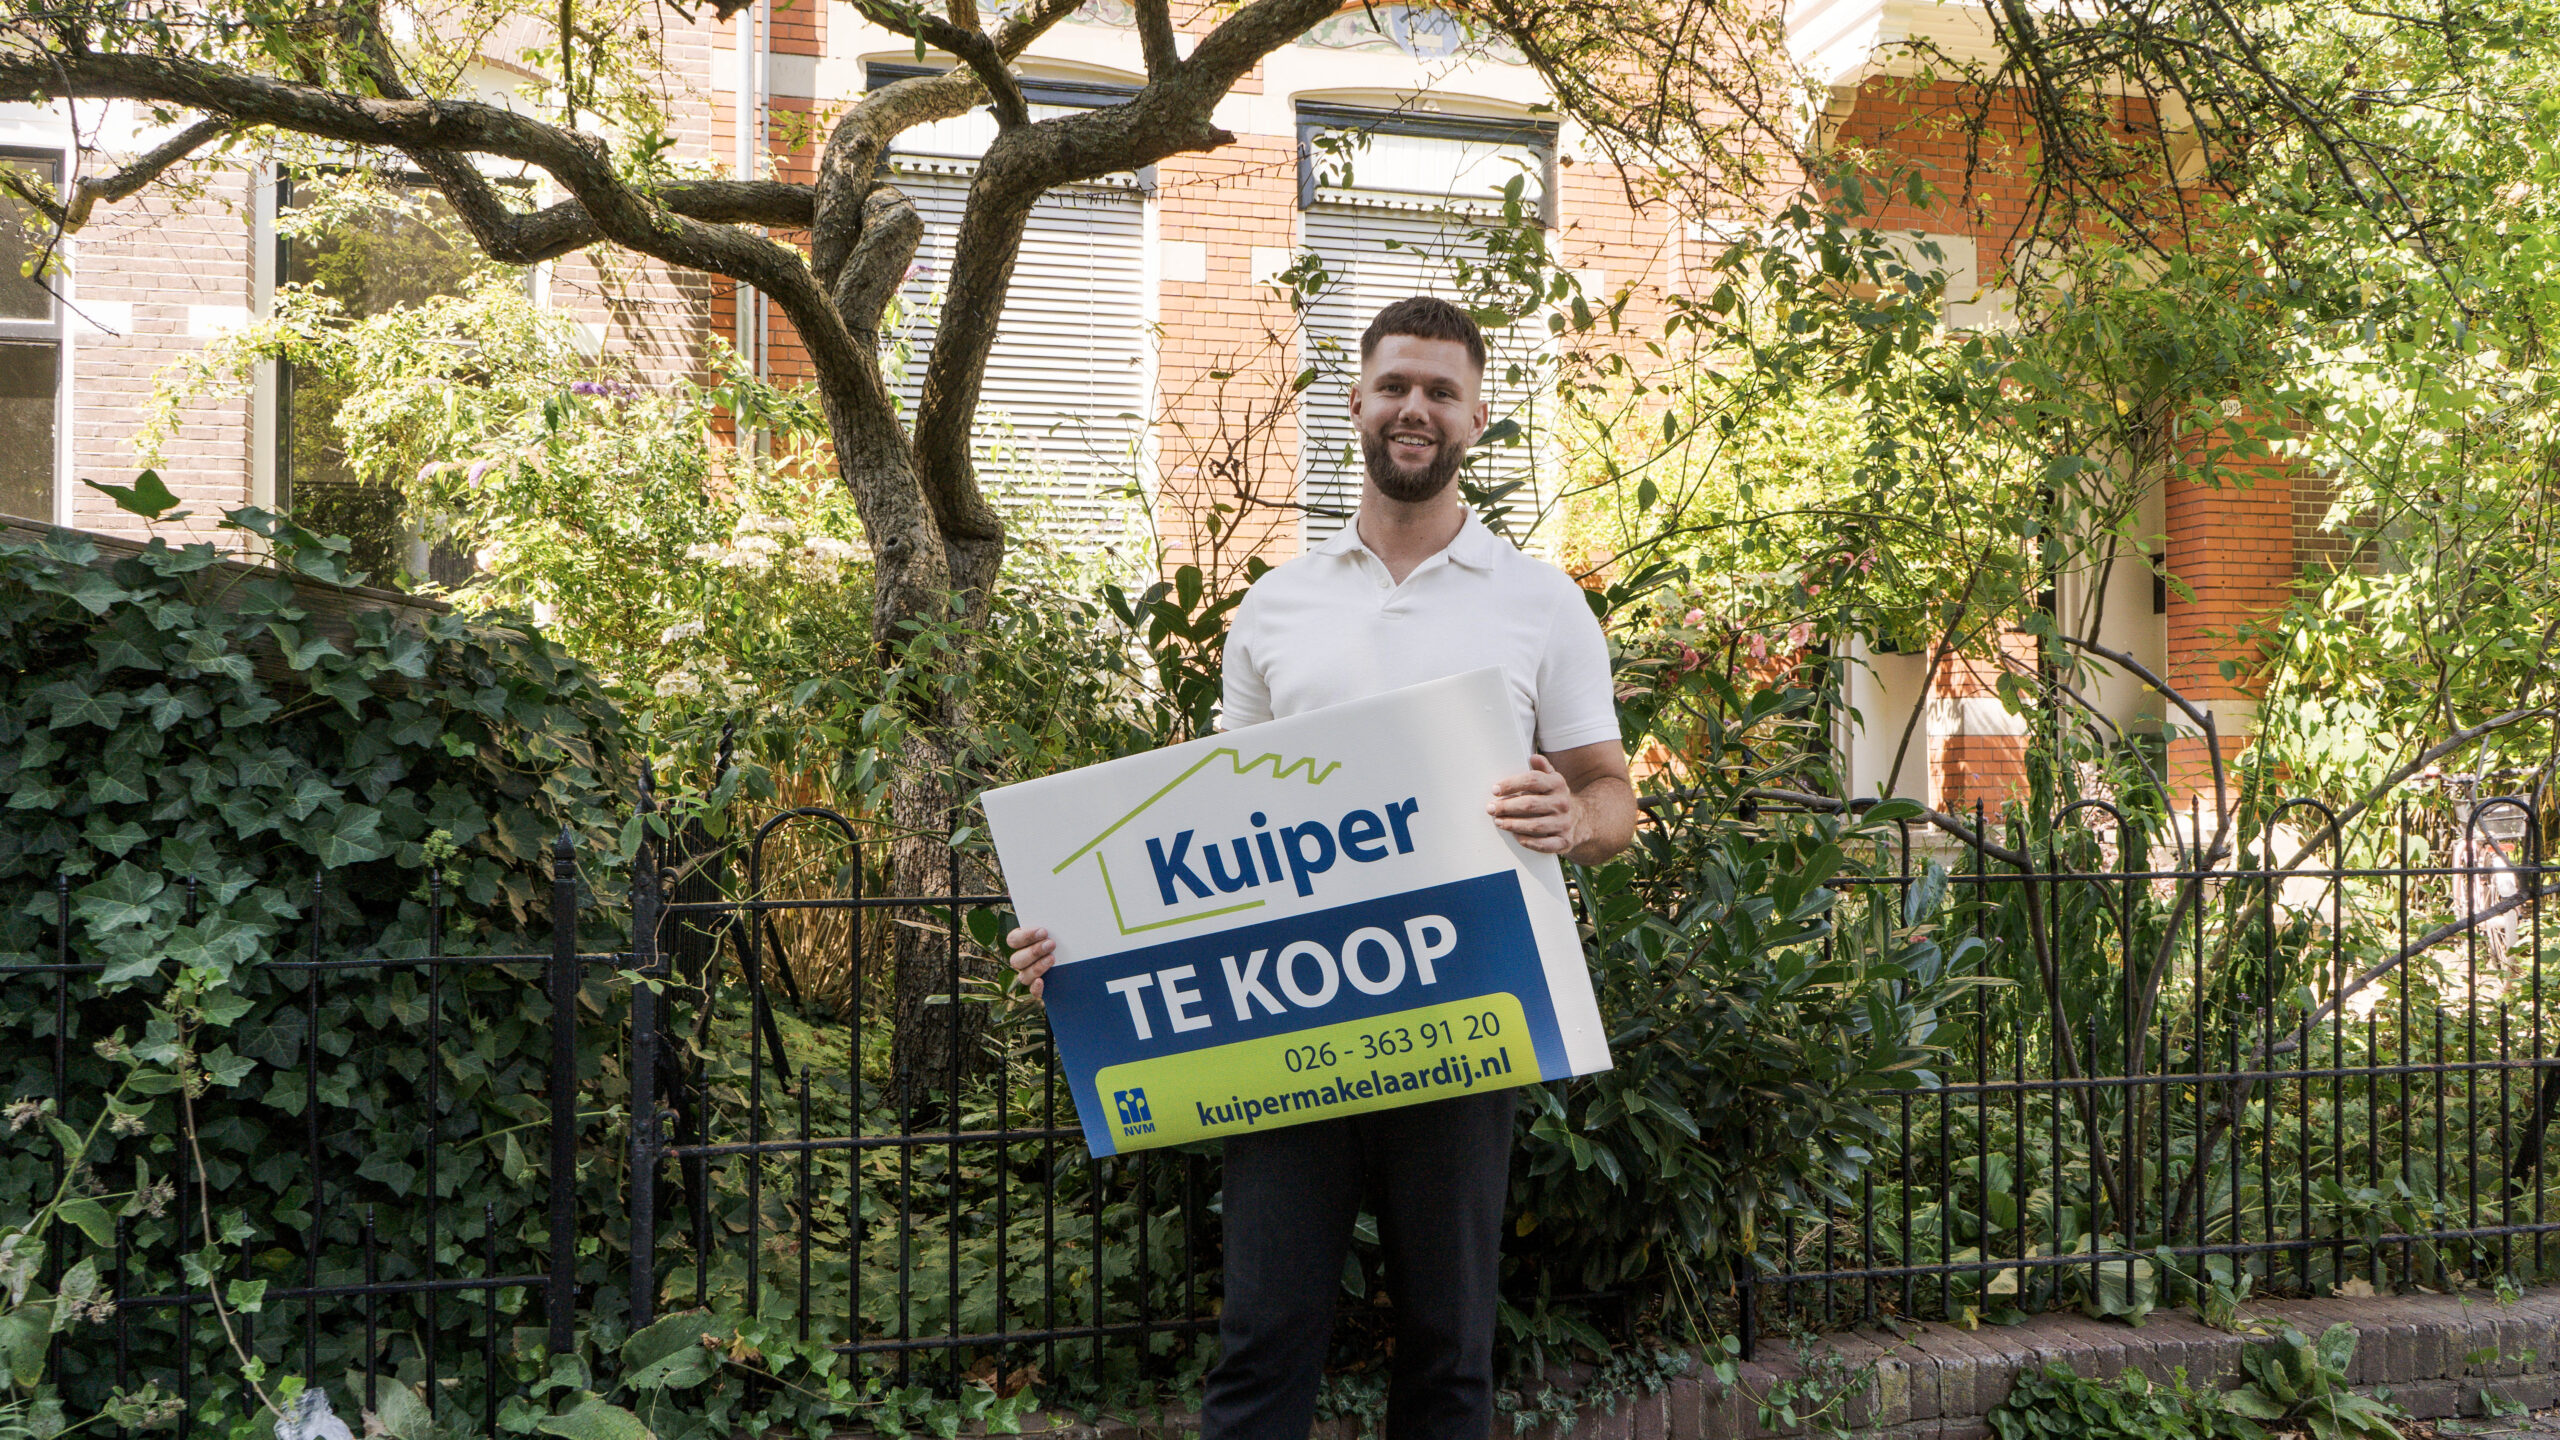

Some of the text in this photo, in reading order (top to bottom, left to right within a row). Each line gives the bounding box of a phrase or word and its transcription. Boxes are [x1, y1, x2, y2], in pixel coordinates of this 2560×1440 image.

[1146, 797, 1418, 905] Kuiper
[1106, 915, 1457, 1040] TE KOOP
[1284, 1042, 1337, 1073] 026
[1360, 1028, 1413, 1059] 363
[1420, 1020, 1453, 1048] 91
[1463, 1011, 1500, 1041] 20
[1196, 1047, 1512, 1126] kuipermakelaardij.nl
[1123, 1122, 1156, 1137] NVM
